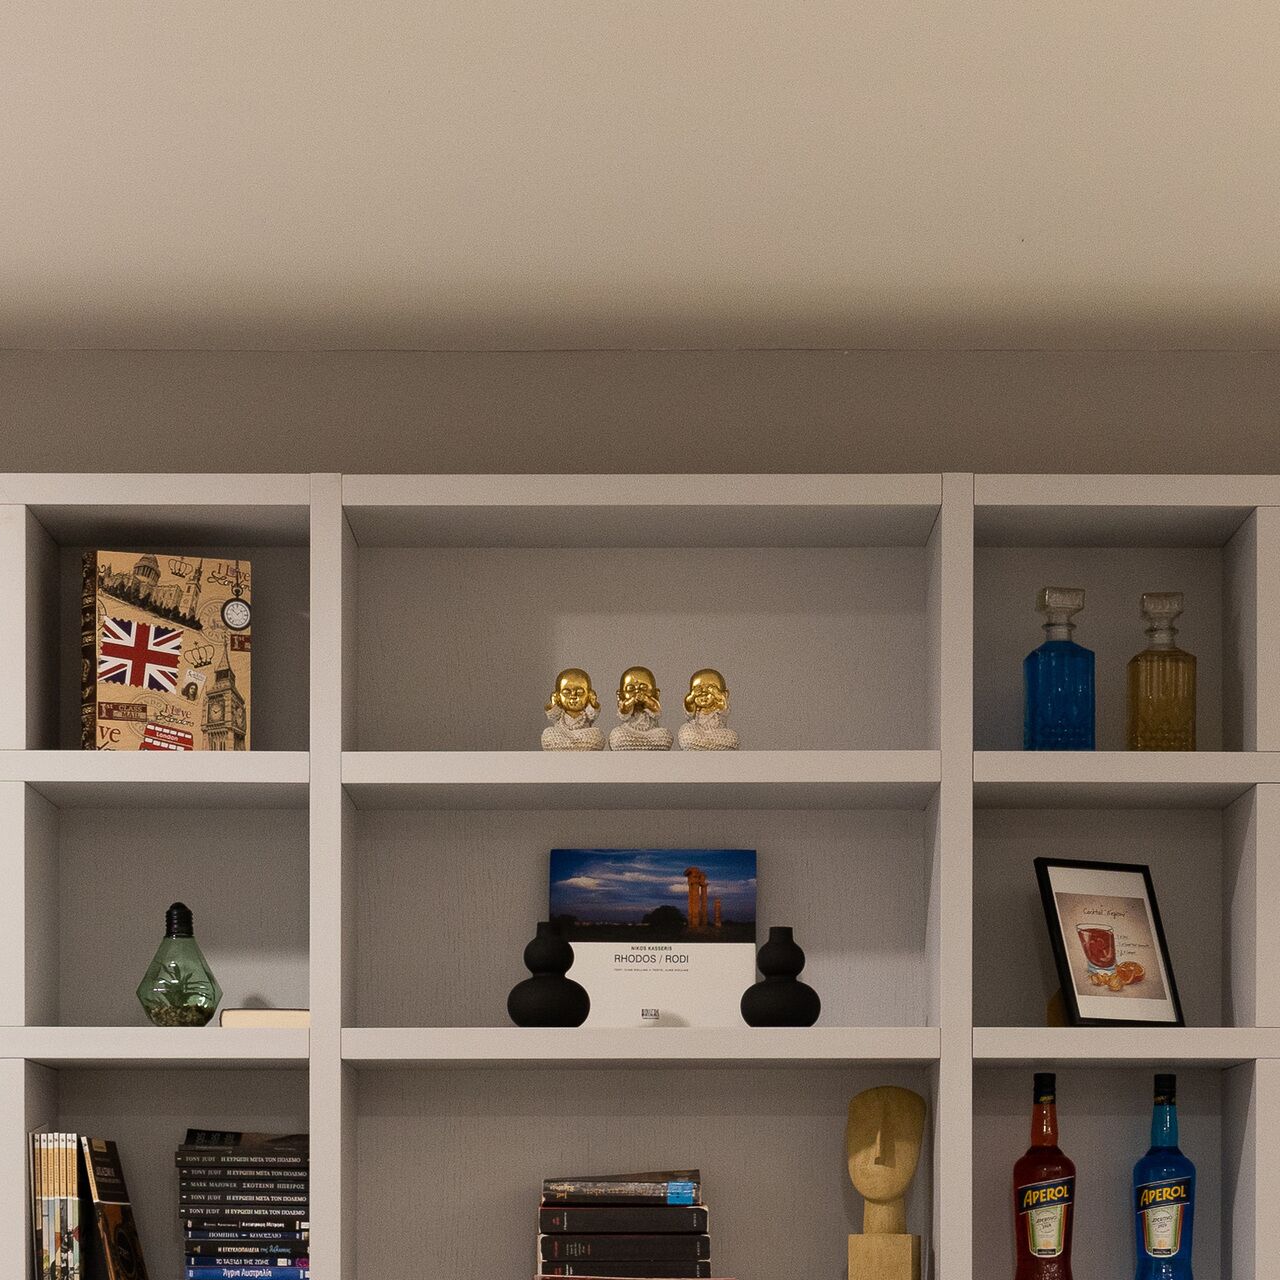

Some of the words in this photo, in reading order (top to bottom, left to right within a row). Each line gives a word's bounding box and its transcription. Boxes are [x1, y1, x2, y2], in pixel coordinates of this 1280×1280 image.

[155, 731, 179, 742] London
[614, 954, 657, 964] RHODOS
[665, 954, 689, 964] RODI
[1023, 1185, 1070, 1208] APEROL
[1140, 1185, 1187, 1207] APEROL
